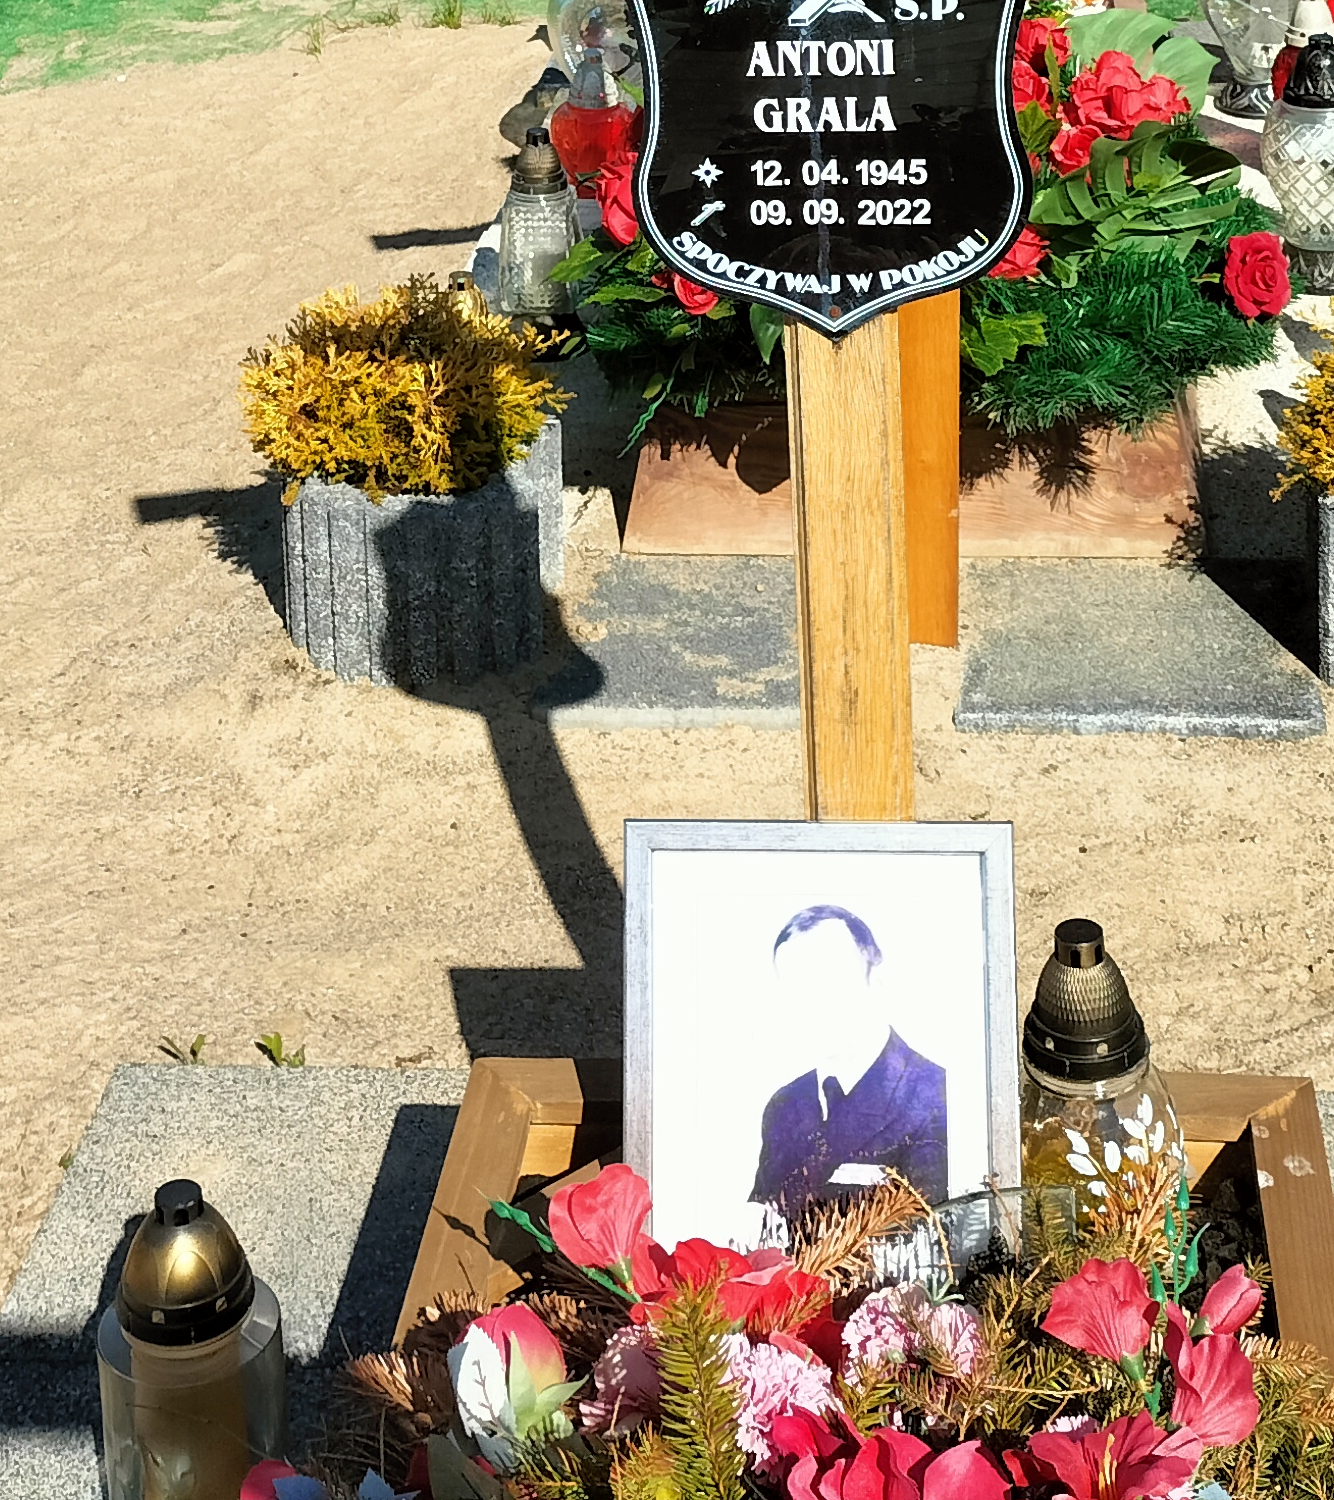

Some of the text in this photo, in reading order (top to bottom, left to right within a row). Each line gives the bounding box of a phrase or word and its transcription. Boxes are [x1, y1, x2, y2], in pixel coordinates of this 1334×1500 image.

[746, 38, 896, 77] ANTONI
[754, 96, 897, 132] GRALA
[672, 229, 989, 295] SPOCZYWAJ W POKOJU
